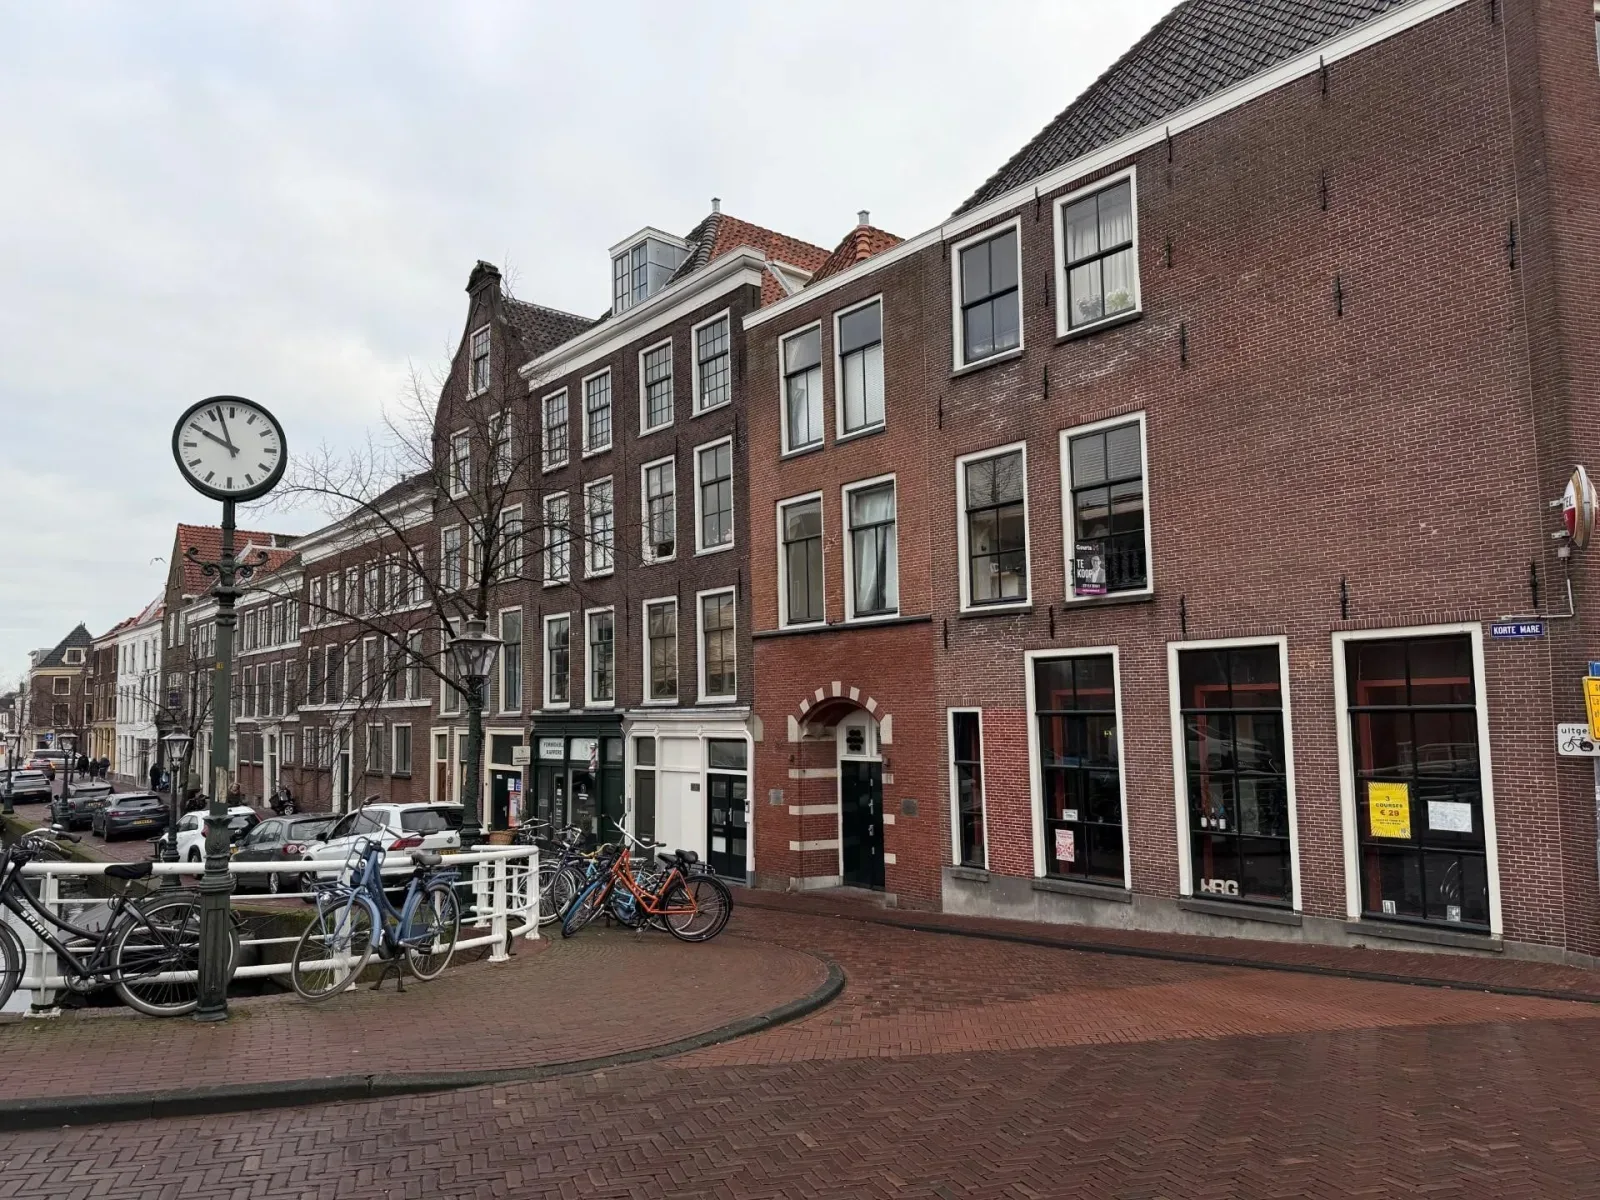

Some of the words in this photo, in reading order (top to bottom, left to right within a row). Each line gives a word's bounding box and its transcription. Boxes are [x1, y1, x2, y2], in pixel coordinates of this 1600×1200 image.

[1076, 559, 1085, 569] TE
[1076, 569, 1093, 579] KOOP
[1493, 626, 1517, 635] KORTE
[1519, 625, 1541, 634] MARE
[1561, 727, 1591, 736] uitge
[20, 909, 53, 940] SPIRIT
